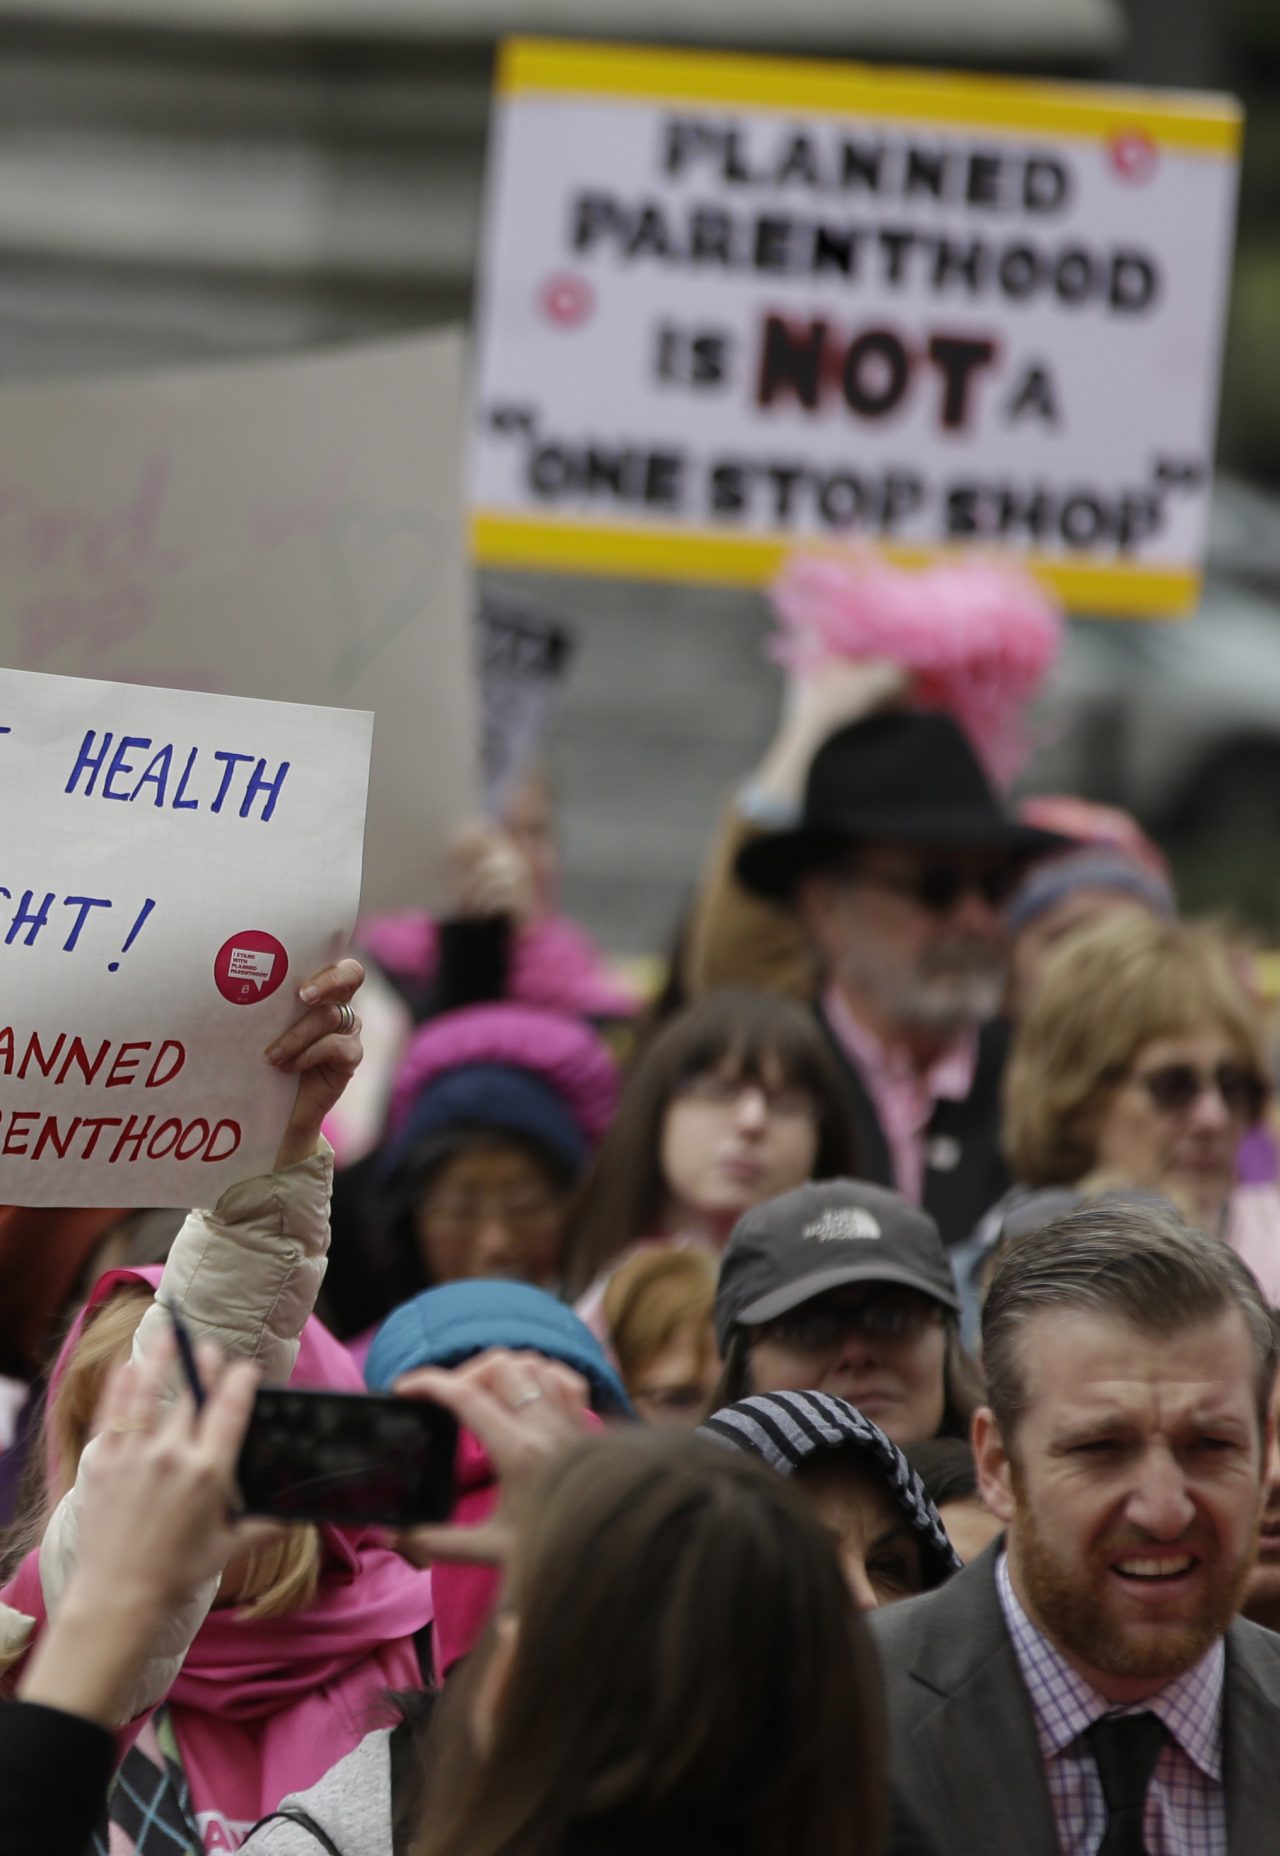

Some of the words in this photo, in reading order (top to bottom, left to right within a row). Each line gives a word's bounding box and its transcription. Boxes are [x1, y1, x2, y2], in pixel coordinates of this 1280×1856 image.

[663, 118, 1070, 213] PLANNED
[571, 192, 1160, 313] PARENTHOOD
[658, 322, 730, 387] IS
[755, 314, 1000, 432] NOT
[1009, 364, 1059, 431] A
[711, 462, 923, 533] STOP
[64, 729, 290, 823] HEALTH
